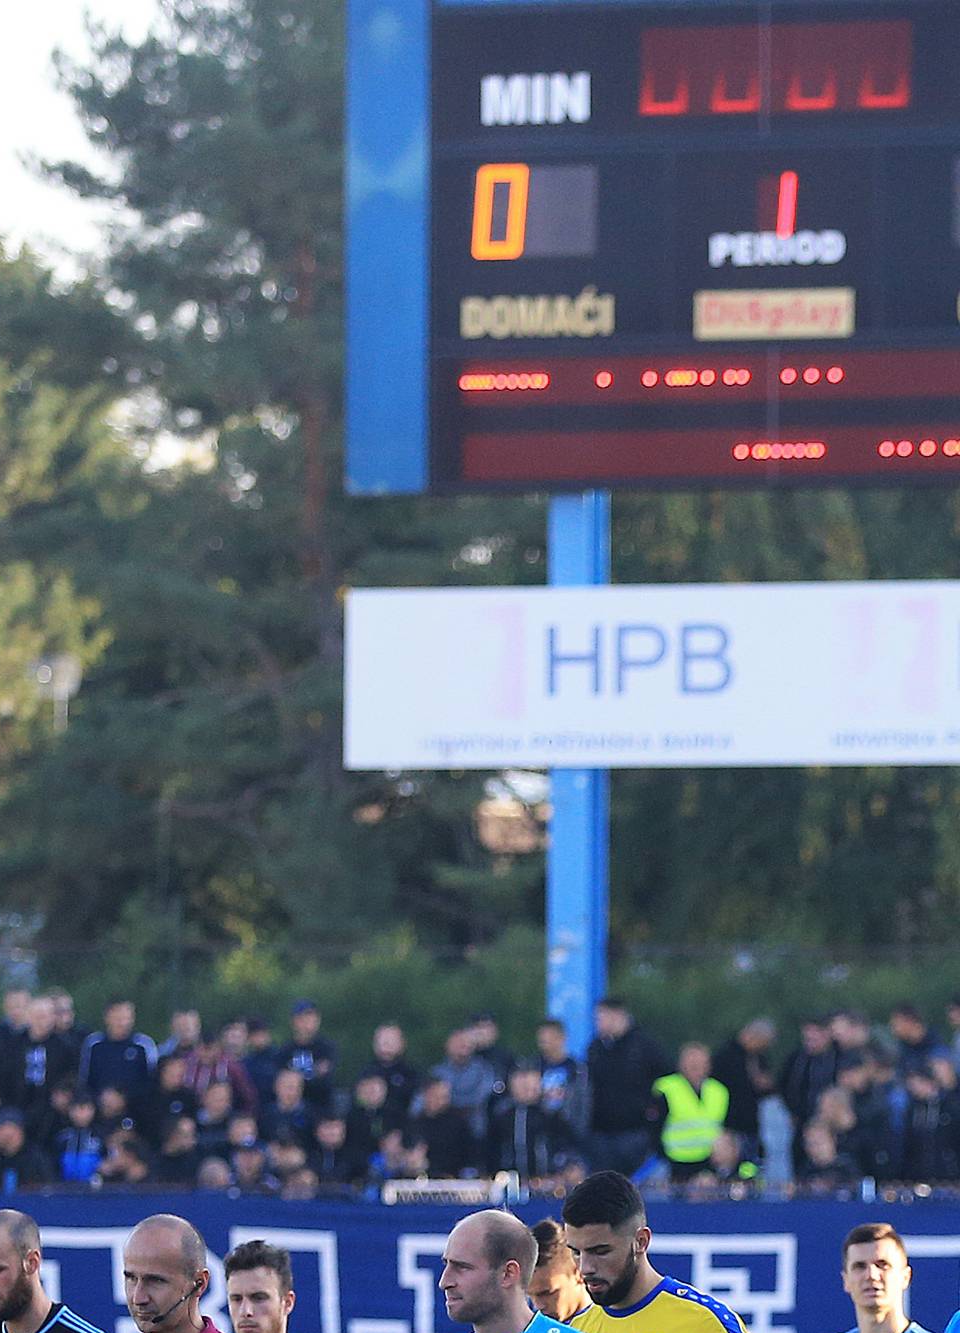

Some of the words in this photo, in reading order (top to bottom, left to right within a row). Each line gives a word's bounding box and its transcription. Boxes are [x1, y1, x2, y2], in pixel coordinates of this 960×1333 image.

[480, 72, 591, 125] MIN
[471, 163, 529, 260] 0
[547, 623, 733, 696] HPB
